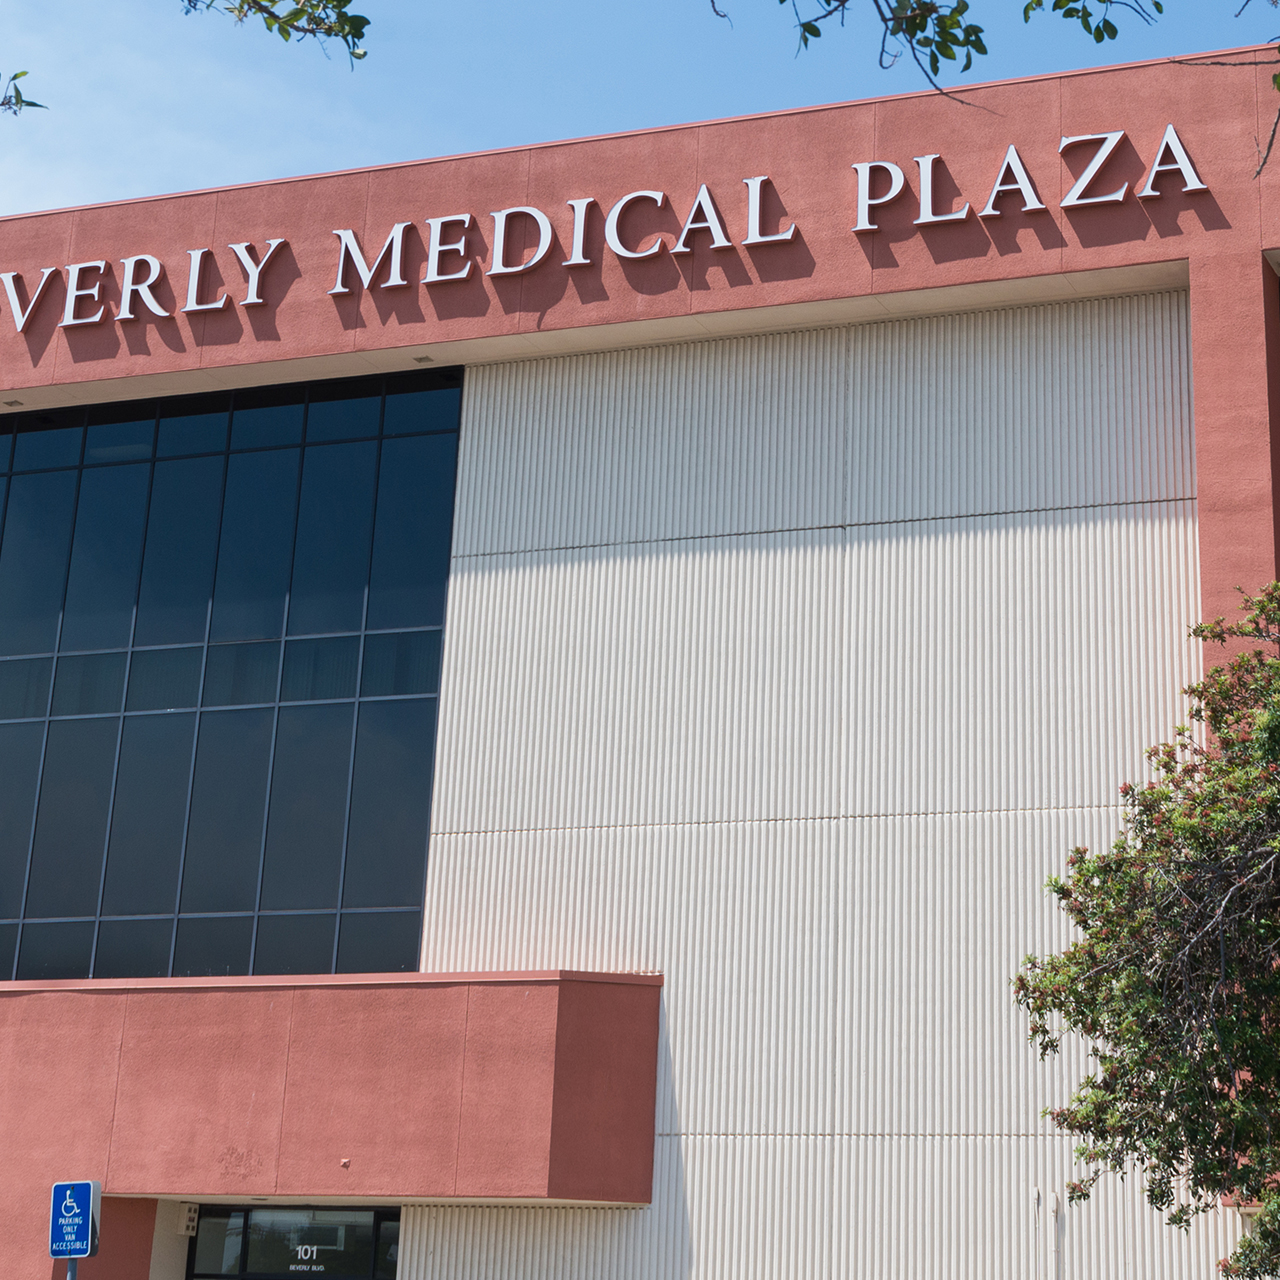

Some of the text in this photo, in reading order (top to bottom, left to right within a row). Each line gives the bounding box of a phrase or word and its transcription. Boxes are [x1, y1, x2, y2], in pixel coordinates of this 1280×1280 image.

[327, 175, 796, 296] MEDICAL
[851, 123, 1208, 233] PLAZA
[58, 1216, 83, 1225] PARKING
[63, 1225, 77, 1233] ONLY
[65, 1233, 76, 1241] VAN
[52, 1241, 87, 1250] ACCESSIBLE
[296, 1245, 317, 1260] 101
